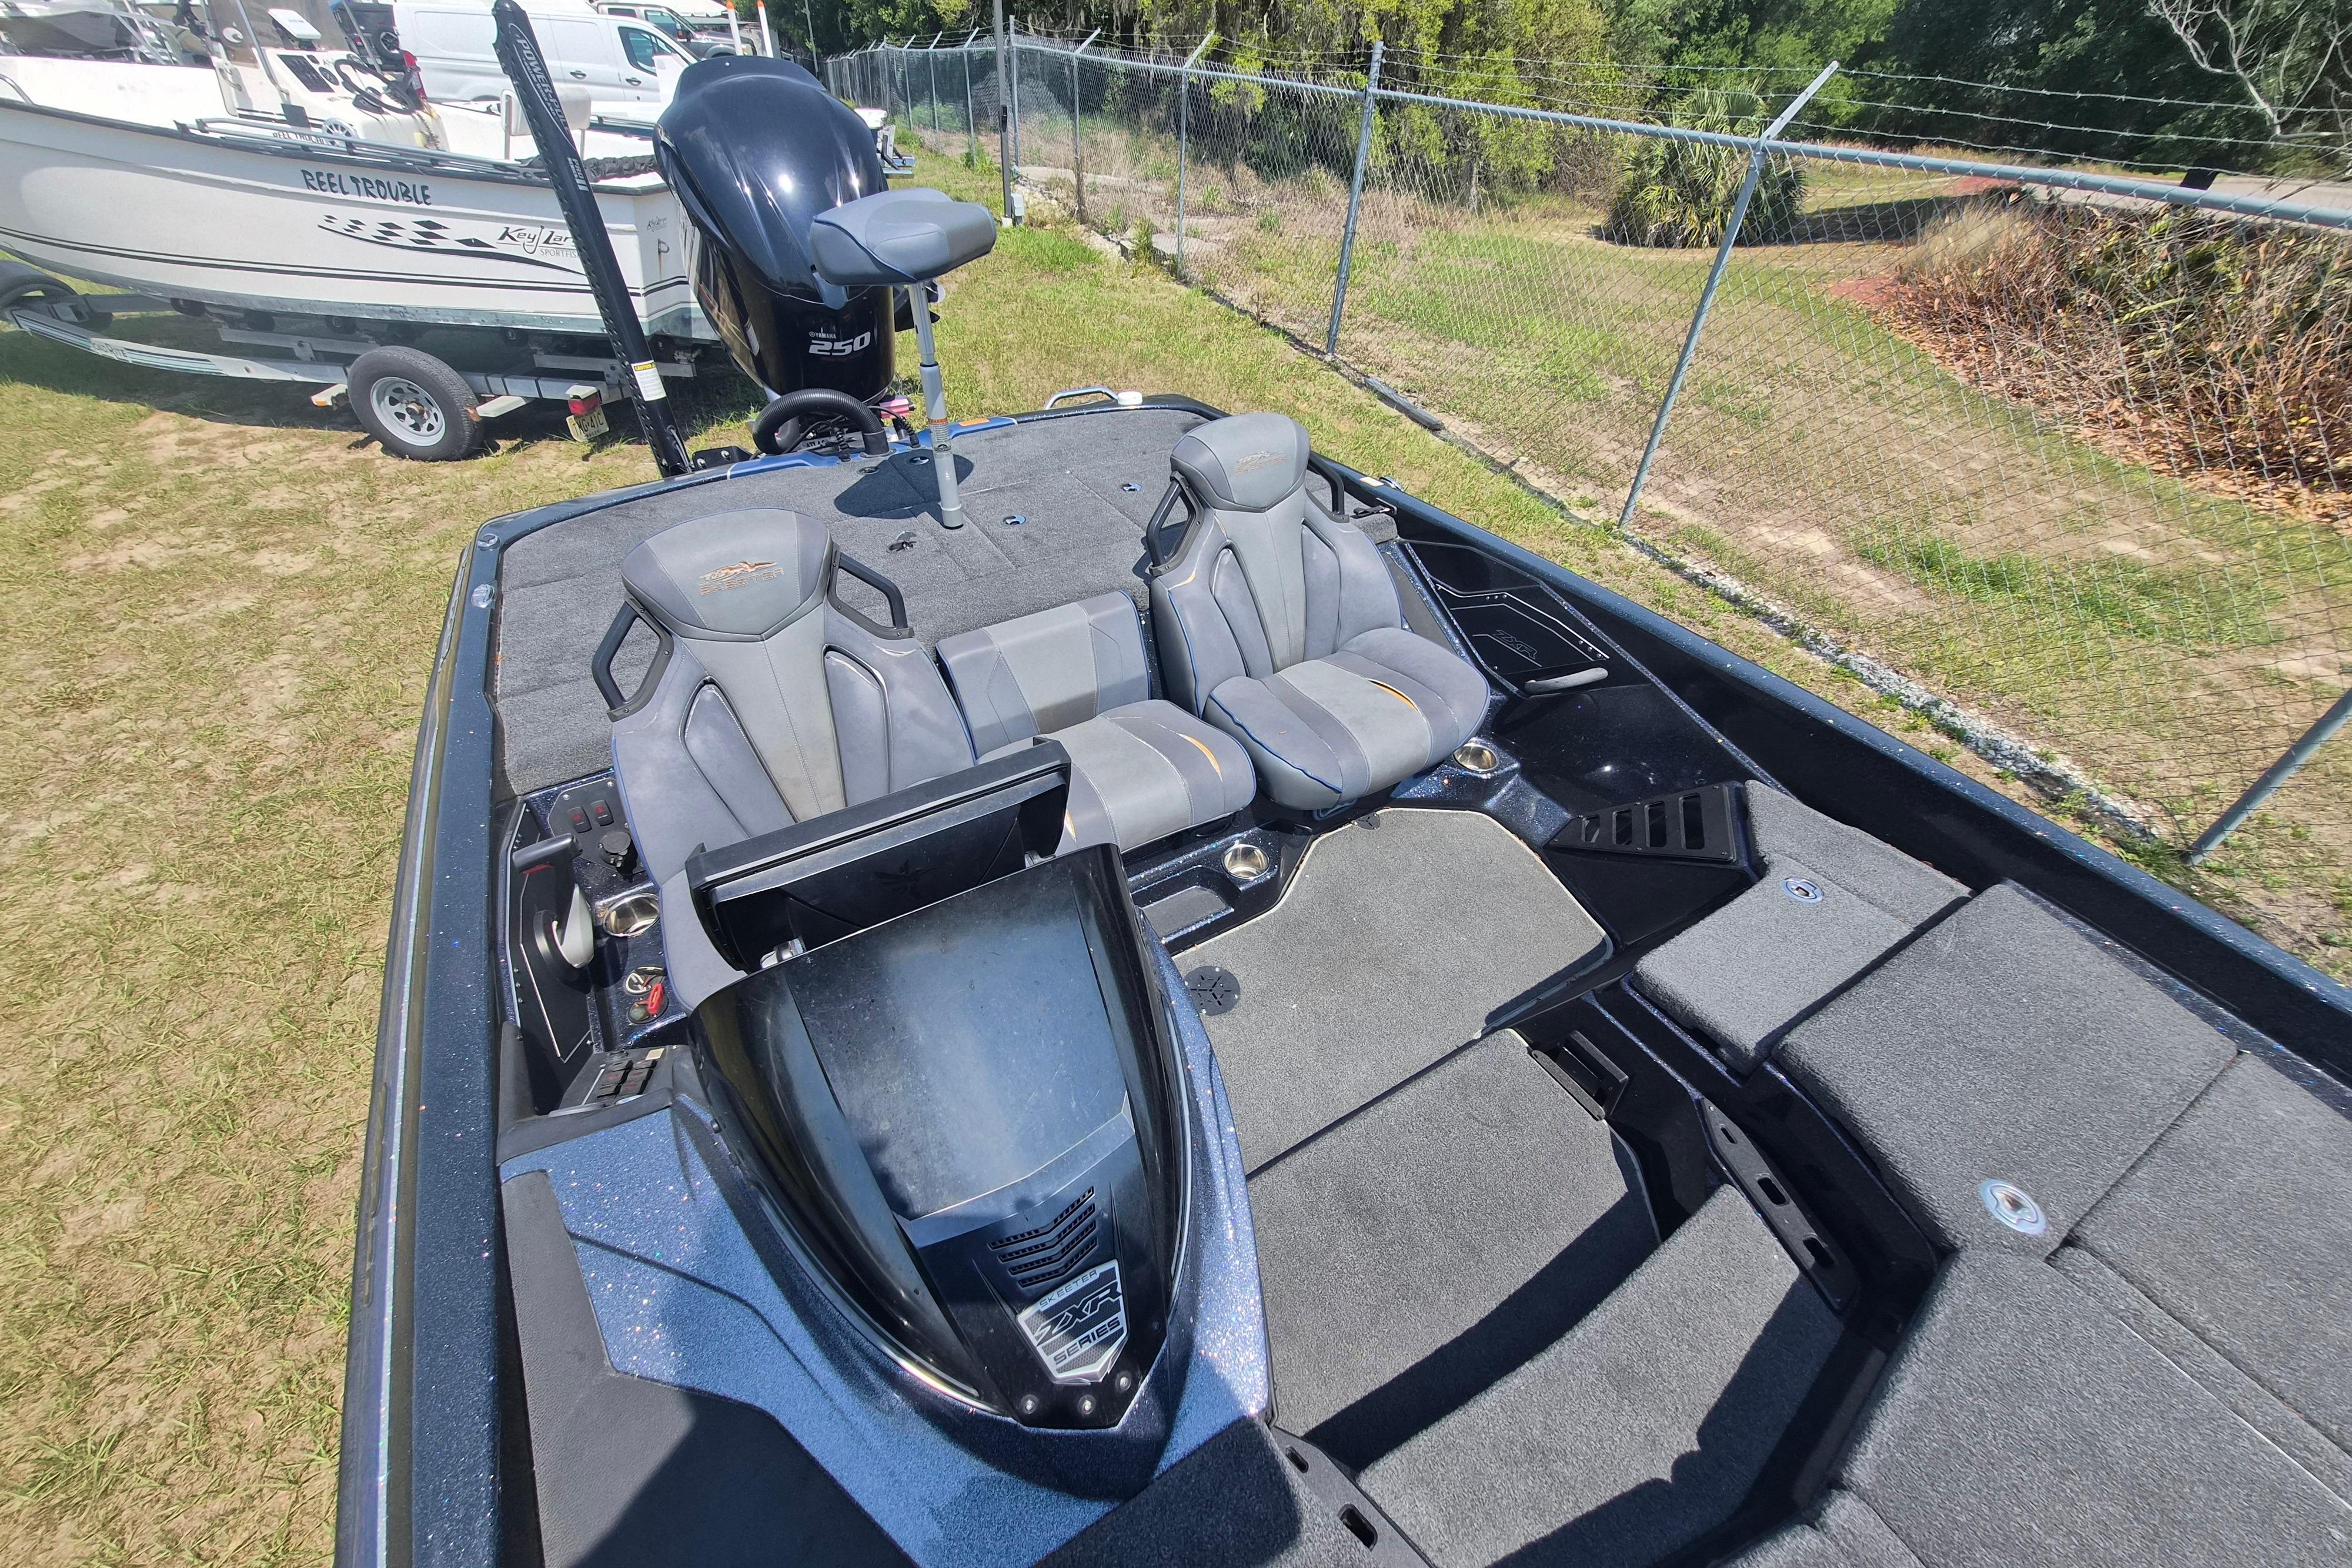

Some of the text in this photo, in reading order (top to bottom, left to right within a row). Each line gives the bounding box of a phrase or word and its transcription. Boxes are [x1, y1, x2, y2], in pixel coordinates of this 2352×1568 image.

[300, 169, 432, 205] REEL TROUBLE
[497, 226, 574, 246] Key Lar
[540, 248, 579, 259] SPORTFIS
[808, 332, 871, 356] 250
[699, 567, 785, 596] SKEETER
[1492, 630, 1538, 660] ZXR
[1040, 1269, 1098, 1308] SKEETER
[1033, 1281, 1122, 1347] ZXR
[1053, 1317, 1121, 1365] SERIES
